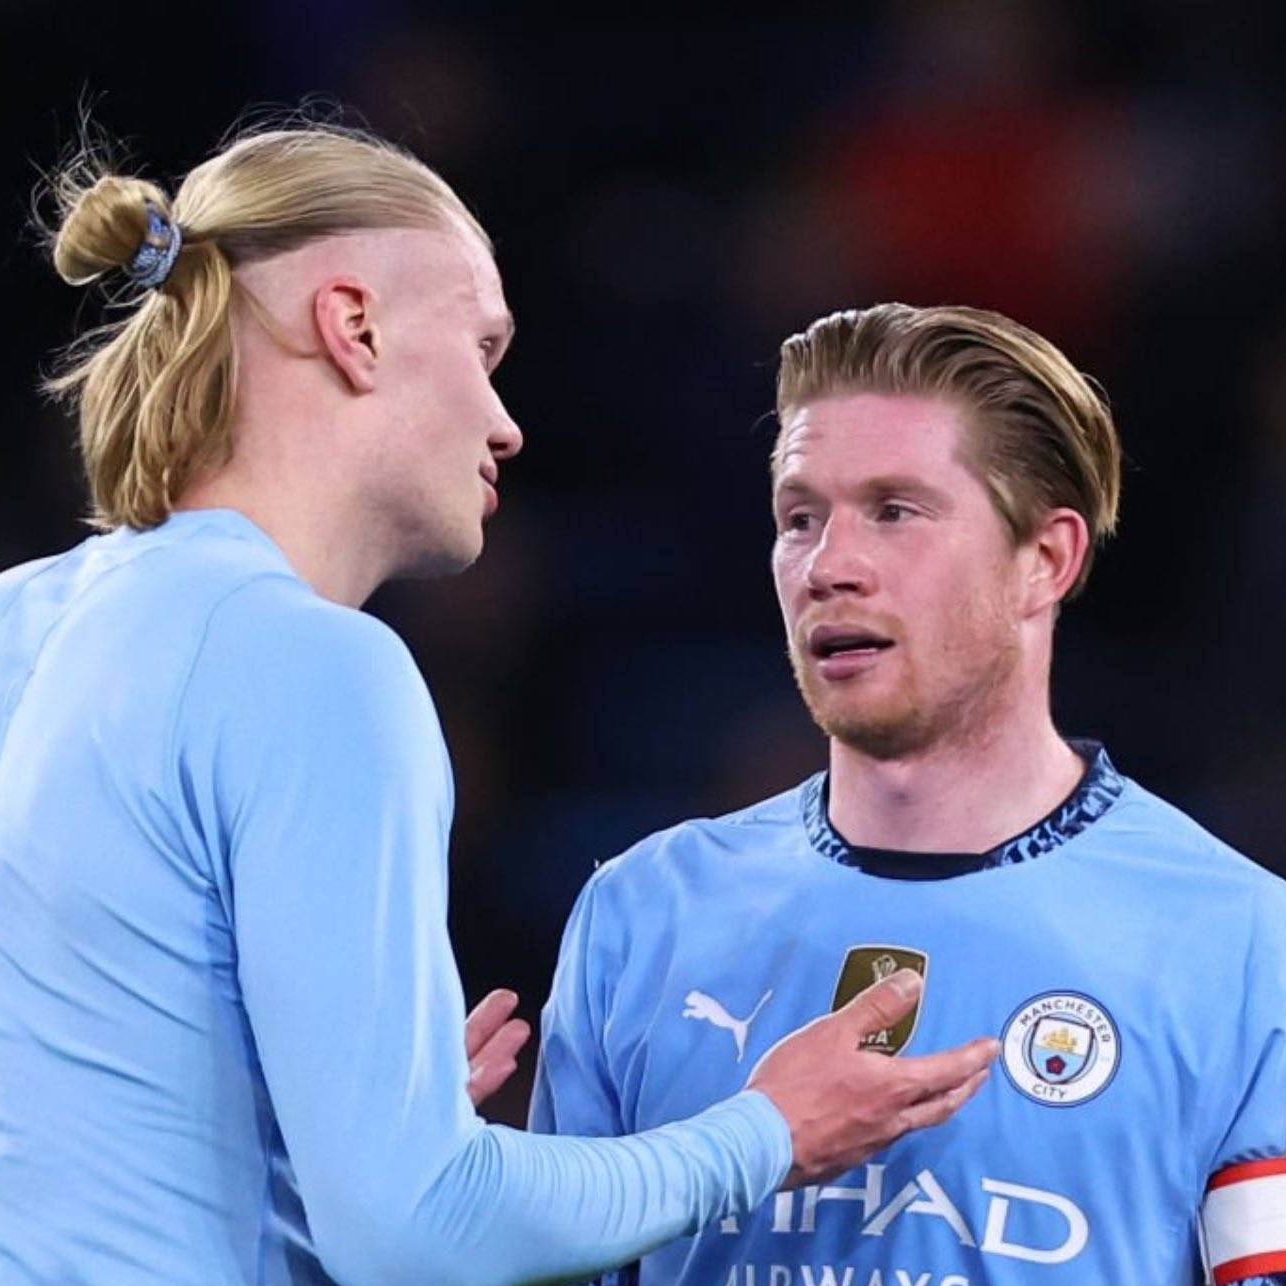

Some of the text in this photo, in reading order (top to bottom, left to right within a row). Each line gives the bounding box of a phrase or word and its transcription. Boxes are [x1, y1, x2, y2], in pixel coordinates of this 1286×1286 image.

[1019, 999, 1111, 1043] MANCHESTER
[1032, 1083, 1066, 1099] CITY
[720, 1163, 1089, 1264] IHAD
